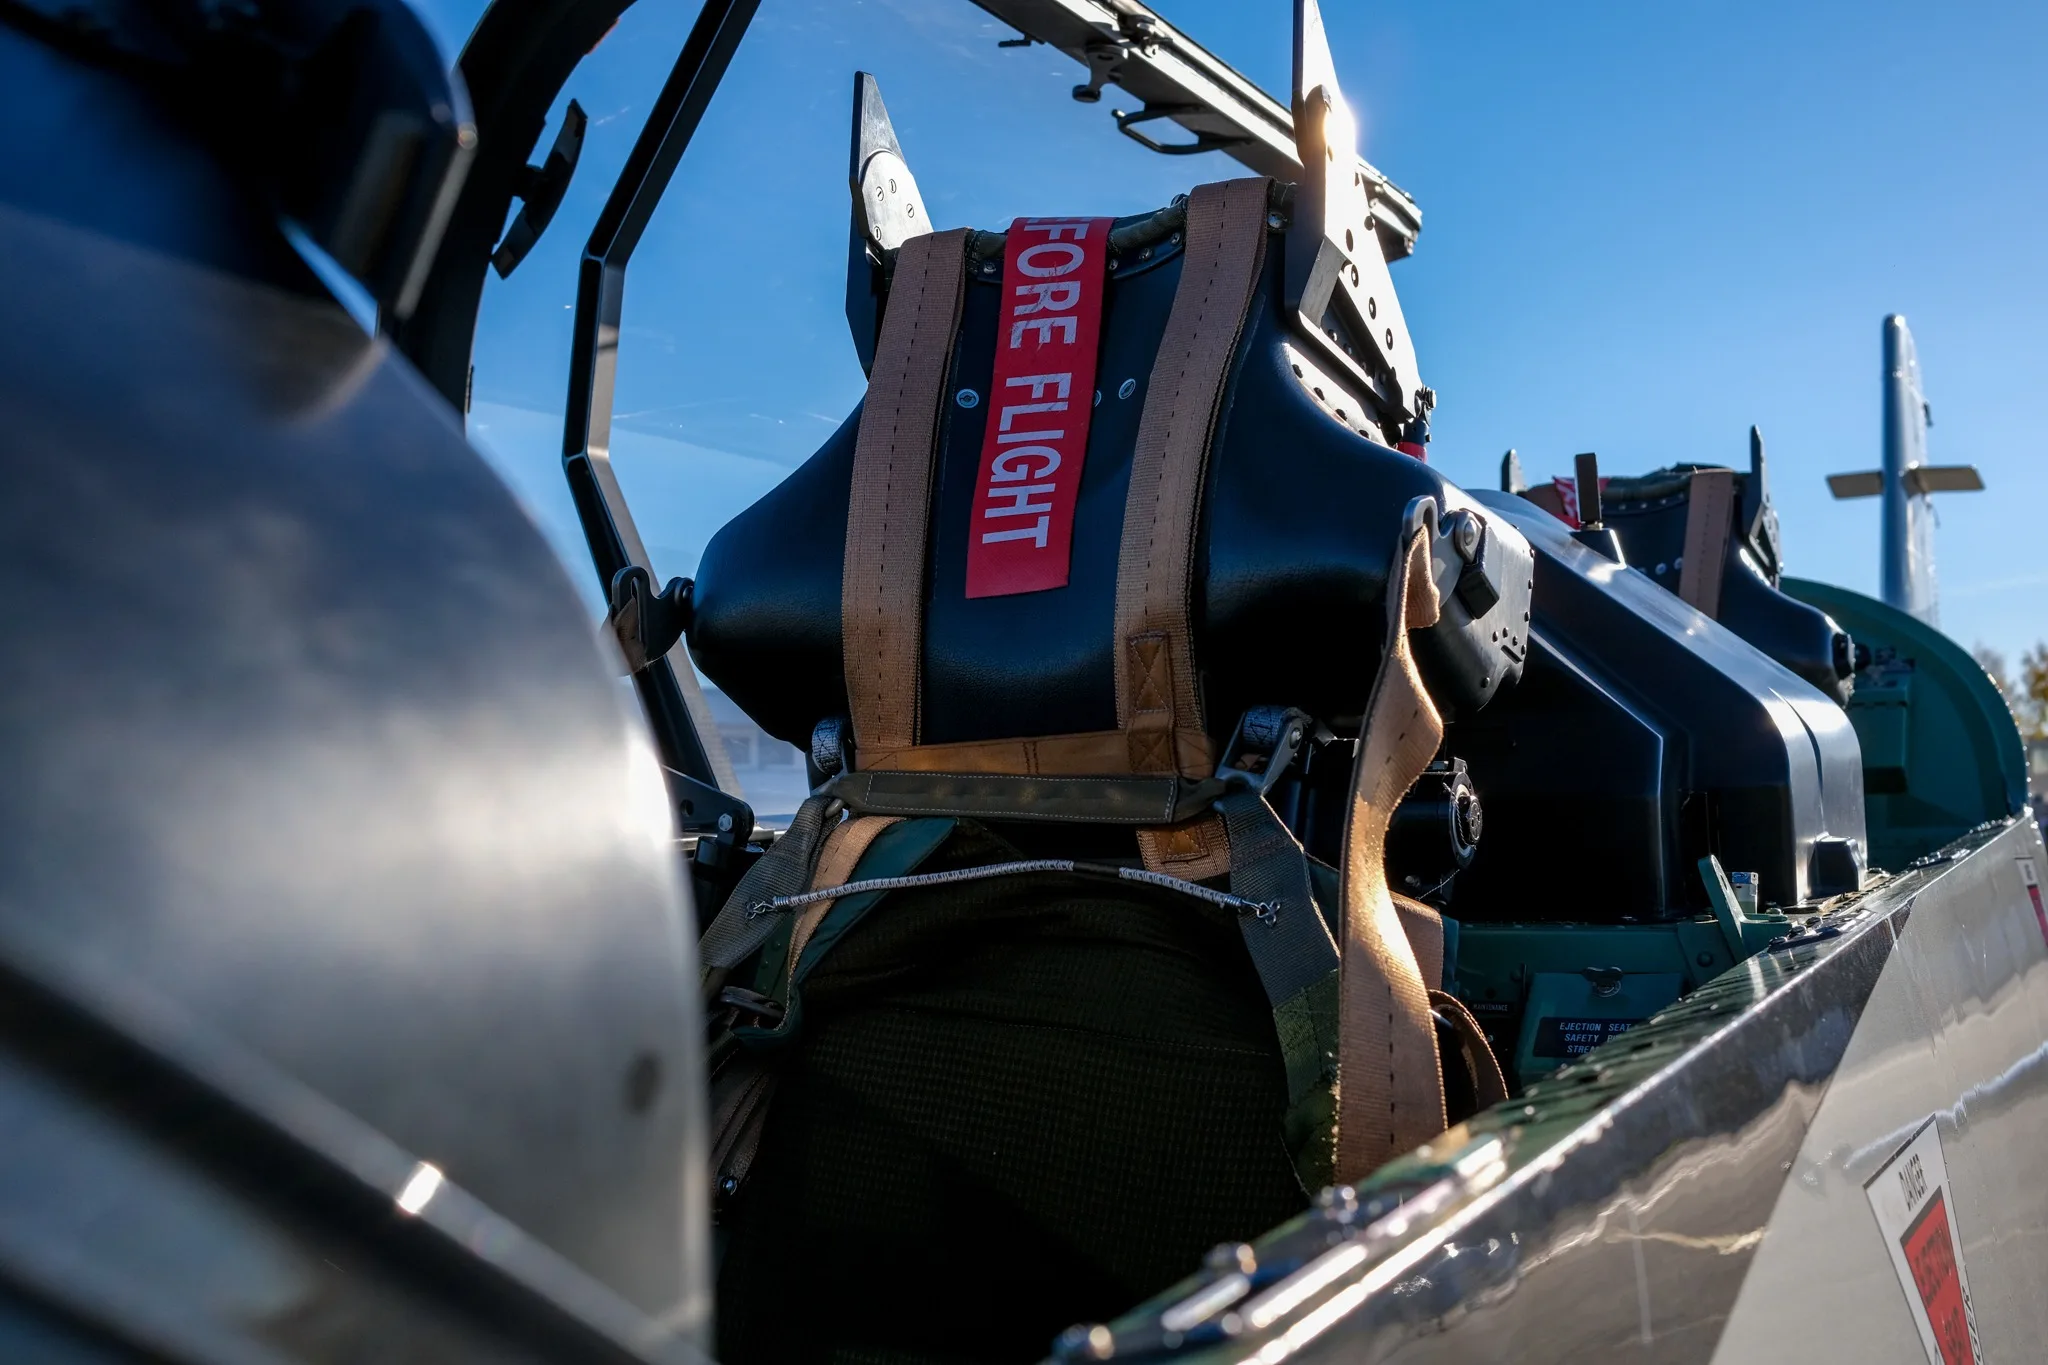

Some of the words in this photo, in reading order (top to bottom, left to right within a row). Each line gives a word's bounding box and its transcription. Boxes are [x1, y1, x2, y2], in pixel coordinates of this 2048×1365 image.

[1009, 217, 1090, 349] FORE
[982, 372, 1073, 549] FLIGHT
[1560, 1022, 1602, 1031] EJECTION
[1608, 1023, 1632, 1032] SEAT
[1564, 1033, 1600, 1043] SAFETY
[1898, 1153, 1928, 1212] DANGER
